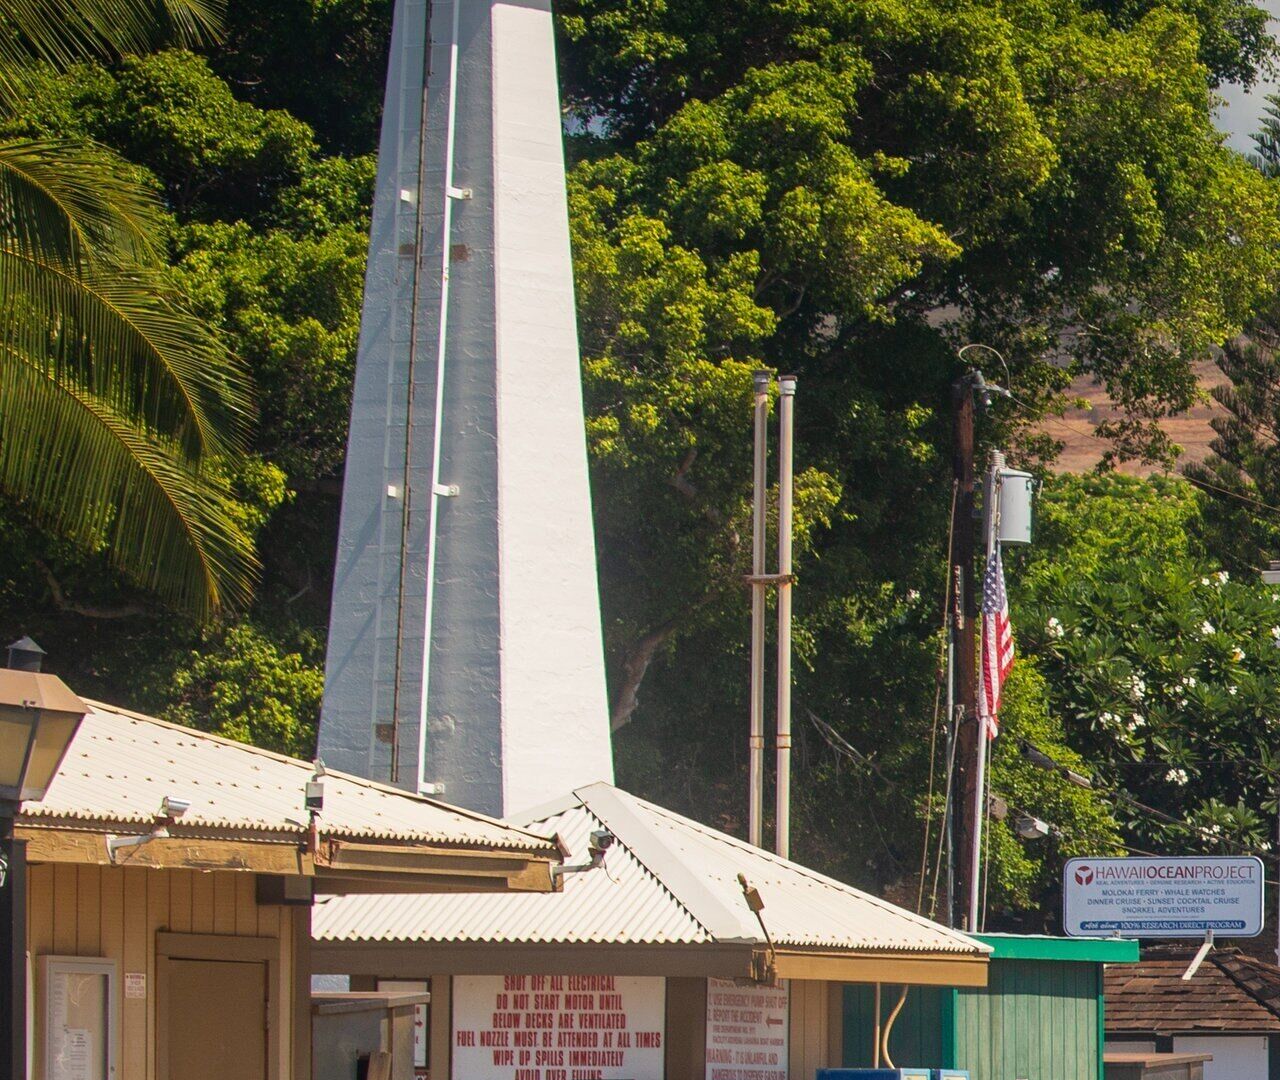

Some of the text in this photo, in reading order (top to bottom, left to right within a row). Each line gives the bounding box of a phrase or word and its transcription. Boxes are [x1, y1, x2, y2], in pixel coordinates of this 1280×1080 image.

[1096, 866, 1255, 879] HAWAIIOCEANPROJECT
[1136, 888, 1159, 896] FERRY
[1192, 888, 1225, 896] WATCHES
[1122, 906, 1156, 914] SNORKEL
[504, 976, 615, 991] SHUT OFF ALL ELECTRICAL
[496, 994, 623, 1010] DO NOT START MOTOR UNTIL
[493, 1013, 626, 1029] BELOW DECKS ARE VENTILATED
[457, 1031, 475, 1048] FUEL
[480, 1031, 509, 1048] NOZZLE
[542, 1031, 552, 1048] BE
[558, 1031, 598, 1048] ATTENDED
[603, 1031, 613, 1048] AT
[617, 1031, 631, 1048] ALL
[636, 1031, 661, 1048] TIMES
[493, 1050, 624, 1067] WIPE UP SPILLS IMMEDIATELY
